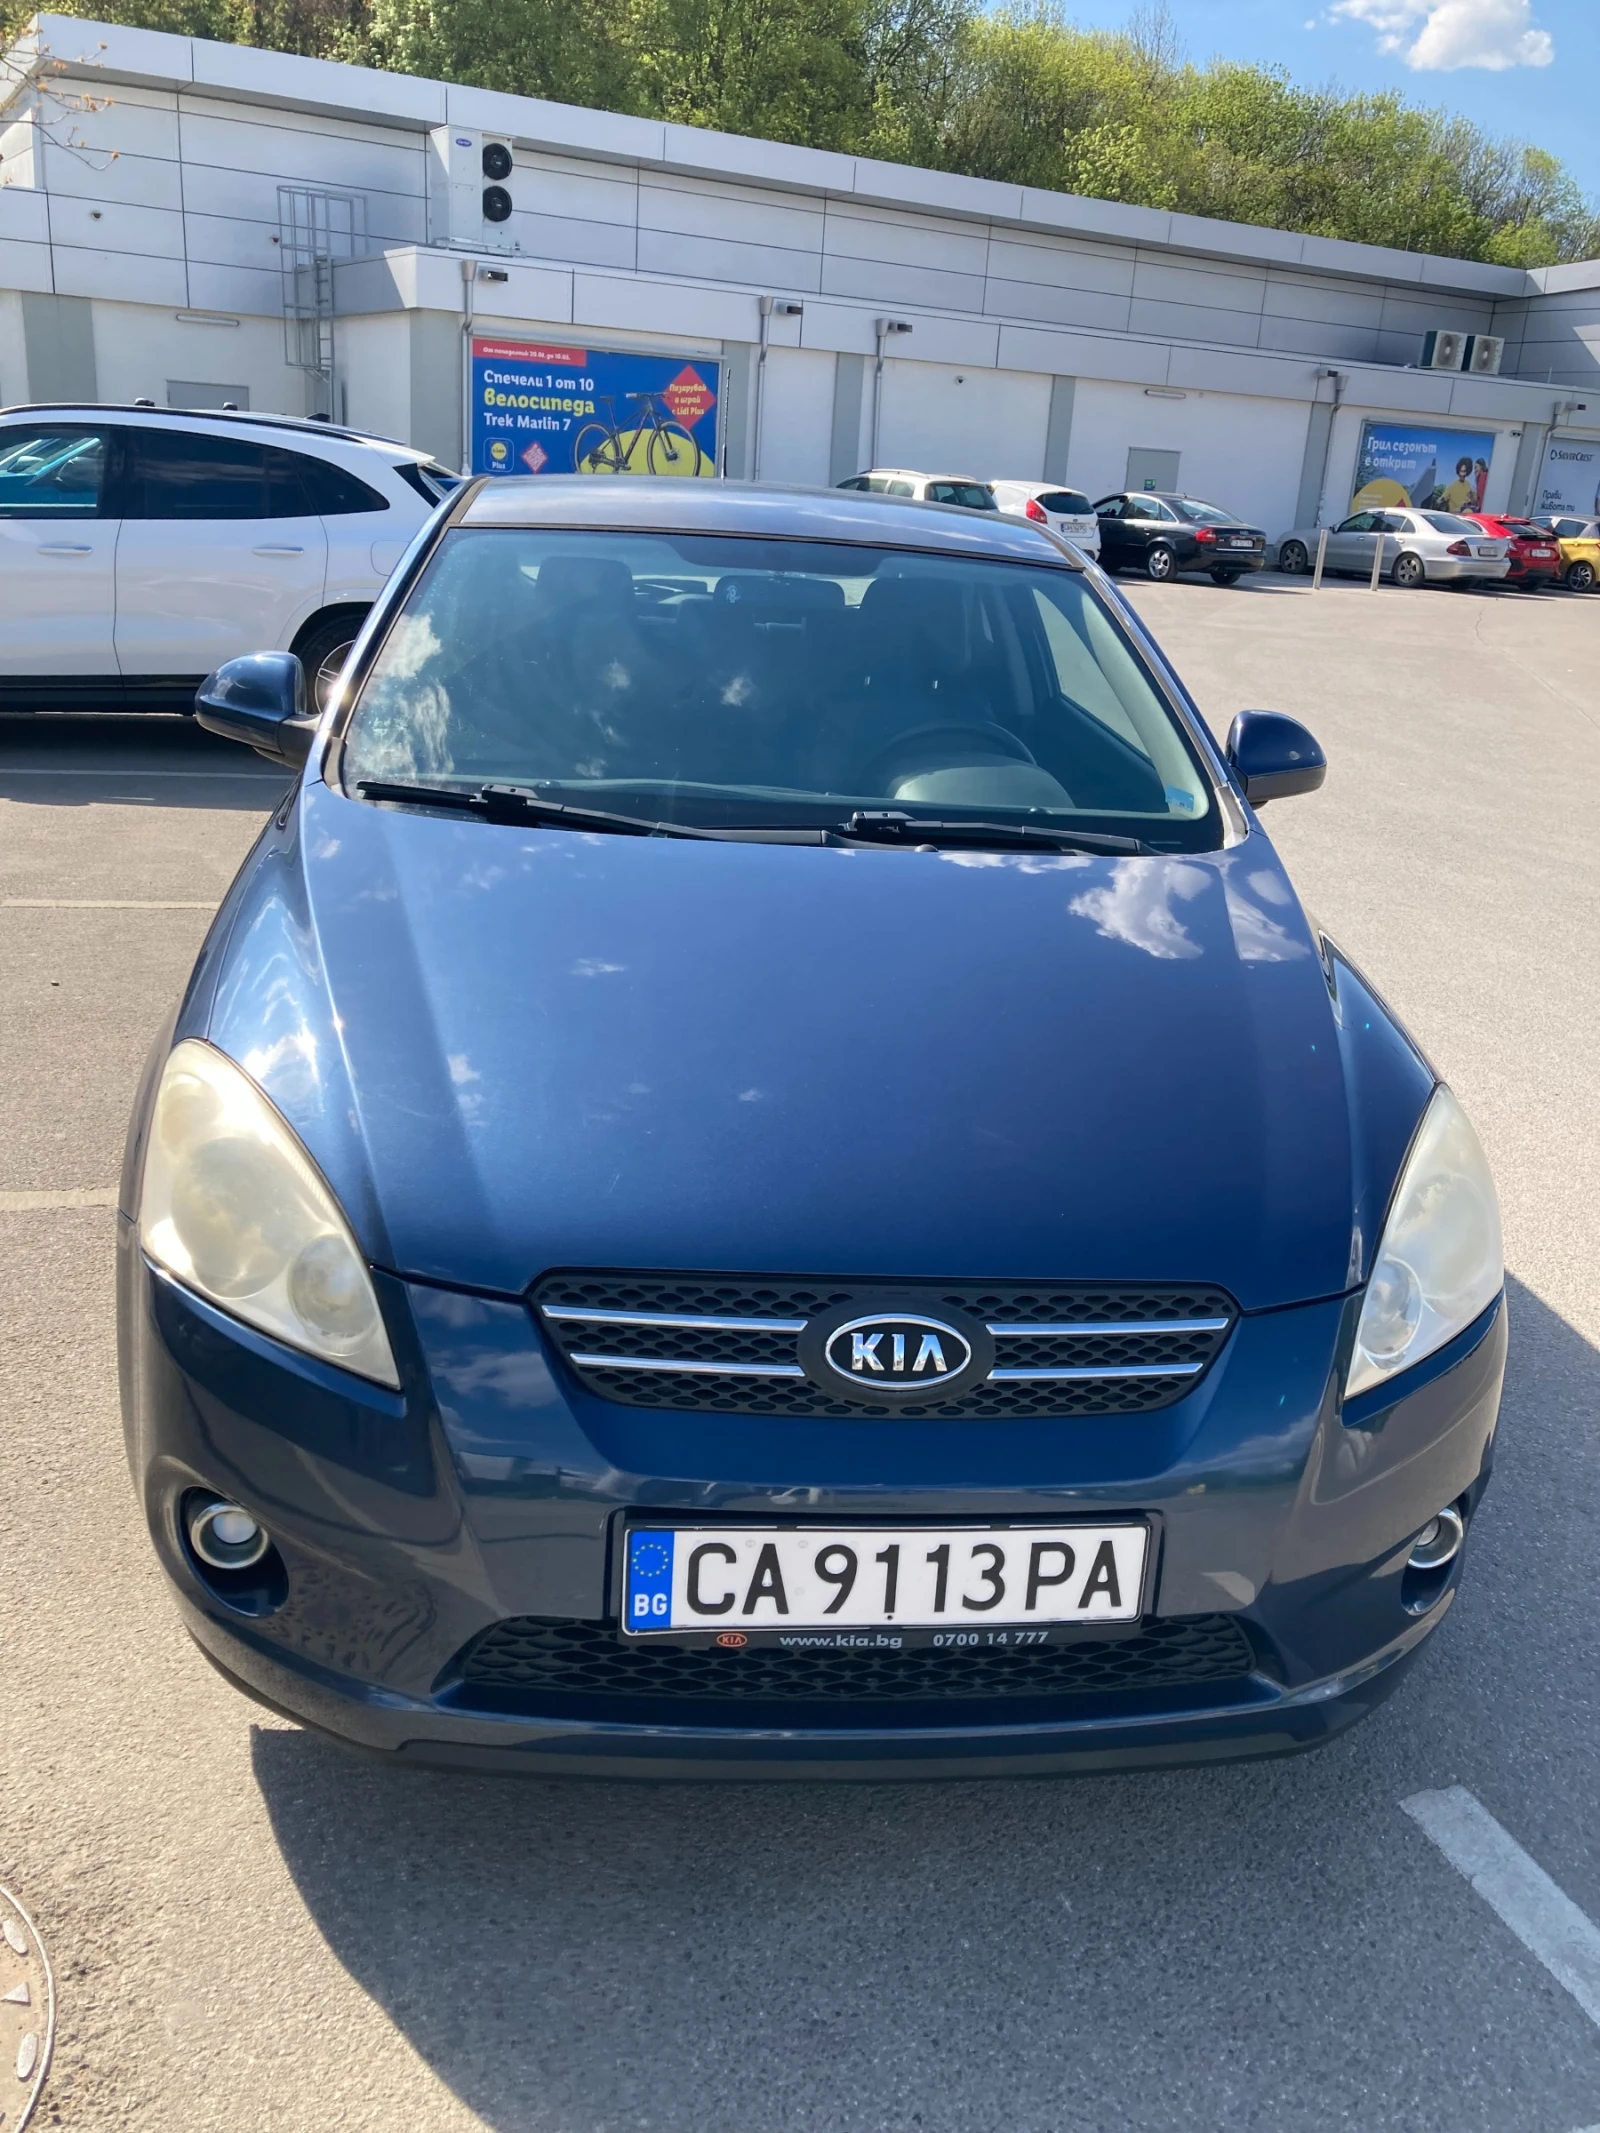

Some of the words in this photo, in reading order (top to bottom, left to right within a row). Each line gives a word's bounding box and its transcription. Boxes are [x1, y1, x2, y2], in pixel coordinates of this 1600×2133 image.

[483, 369, 543, 388] Спечели
[546, 375, 552, 388] 1
[555, 378, 576, 390] от
[579, 377, 595, 391] 10
[484, 387, 595, 417] велосипеда
[677, 407, 690, 415] Lidl
[691, 407, 705, 415] Plus
[483, 412, 514, 427] Trek
[517, 415, 560, 431] Marlin
[563, 418, 571, 431] 7
[1367, 436, 1391, 452] Грил
[1392, 441, 1437, 455] сезонът
[492, 461, 505, 469] Plus
[1365, 456, 1371, 466] е
[1373, 455, 1416, 471] открит
[1542, 490, 1562, 501] Прави
[851, 1332, 948, 1372] KIA
[634, 1593, 667, 1617] BG
[721, 1636, 743, 1645] KIA
[779, 1634, 903, 1649] www.kia.bg
[933, 1632, 979, 1646] 0700
[987, 1632, 1008, 1645] 14
[1014, 1631, 1049, 1644] 777
